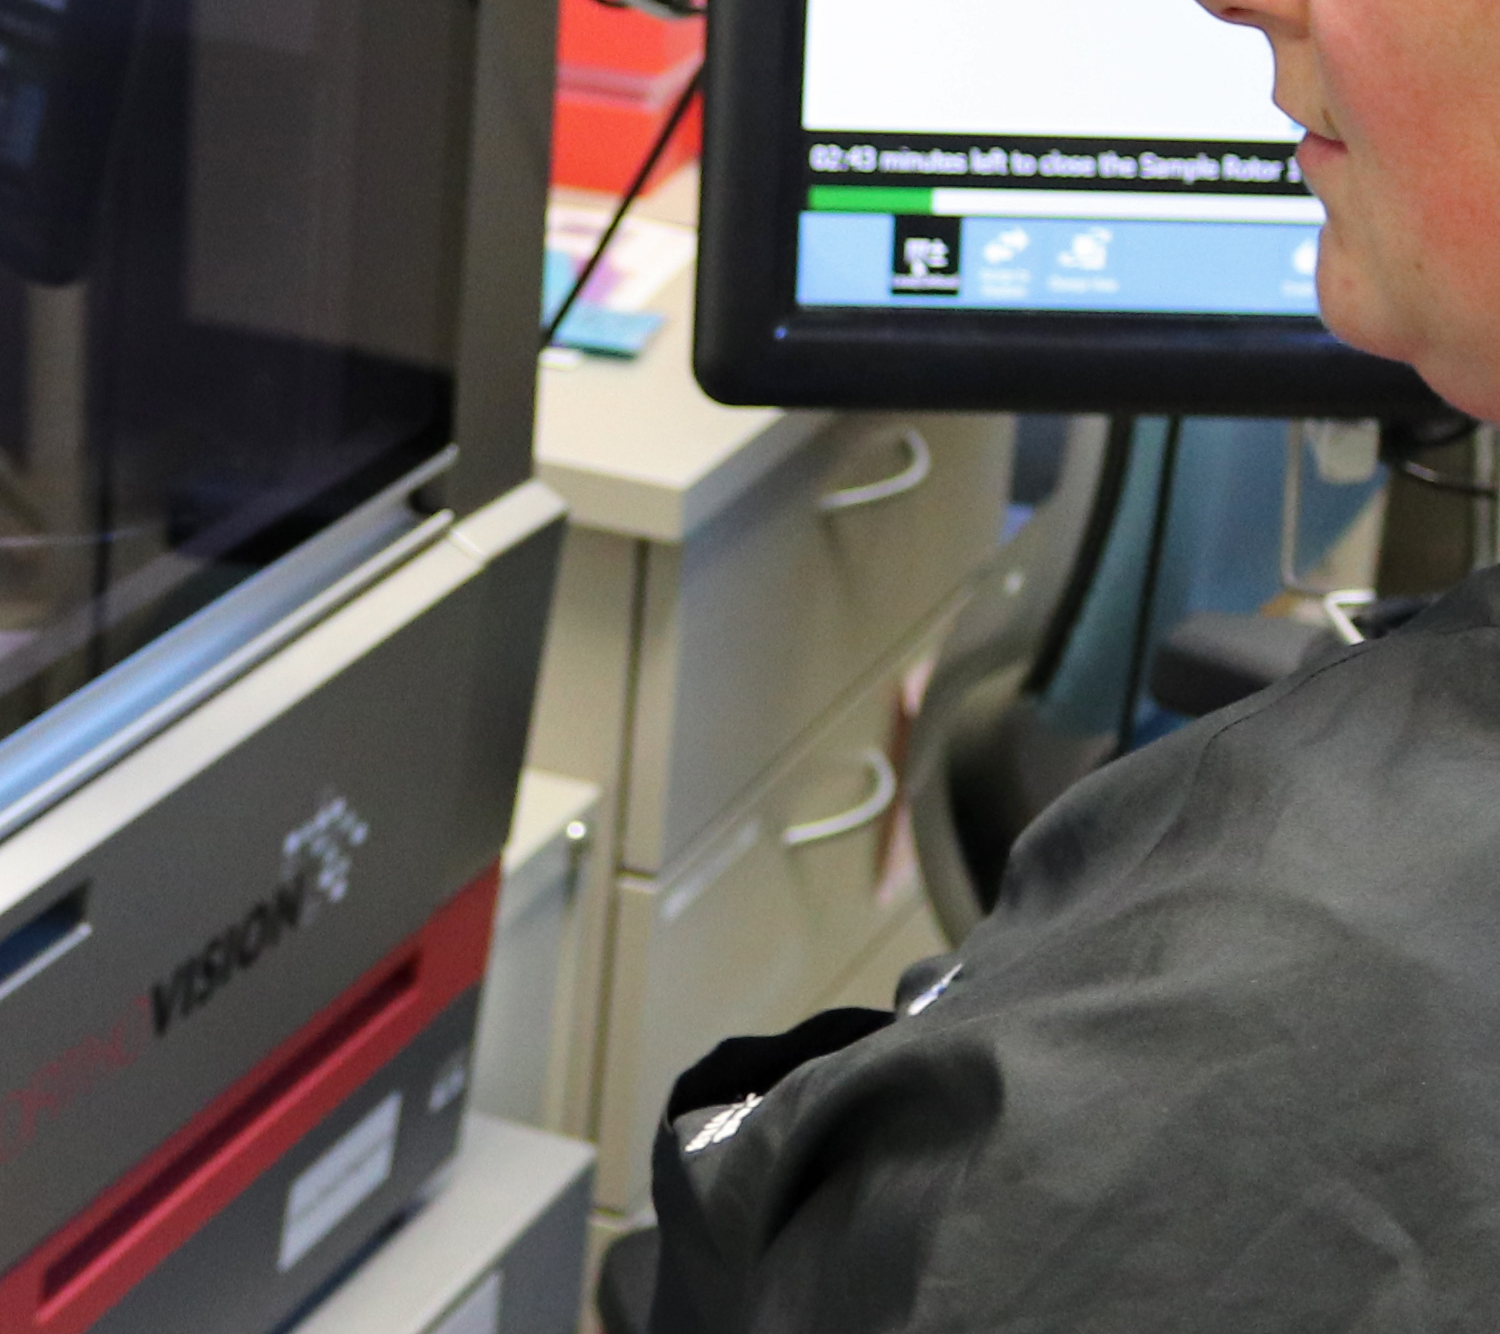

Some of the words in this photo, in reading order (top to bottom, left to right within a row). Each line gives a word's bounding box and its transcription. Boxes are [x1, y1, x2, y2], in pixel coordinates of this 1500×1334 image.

[809, 144, 877, 173] 02:43
[878, 146, 968, 175] minutes
[968, 146, 1008, 177] left
[1010, 149, 1038, 177] to
[1038, 149, 1097, 179] close
[1099, 150, 1136, 179] the
[1137, 151, 1220, 185] Sample
[1220, 152, 1284, 181] Rotor
